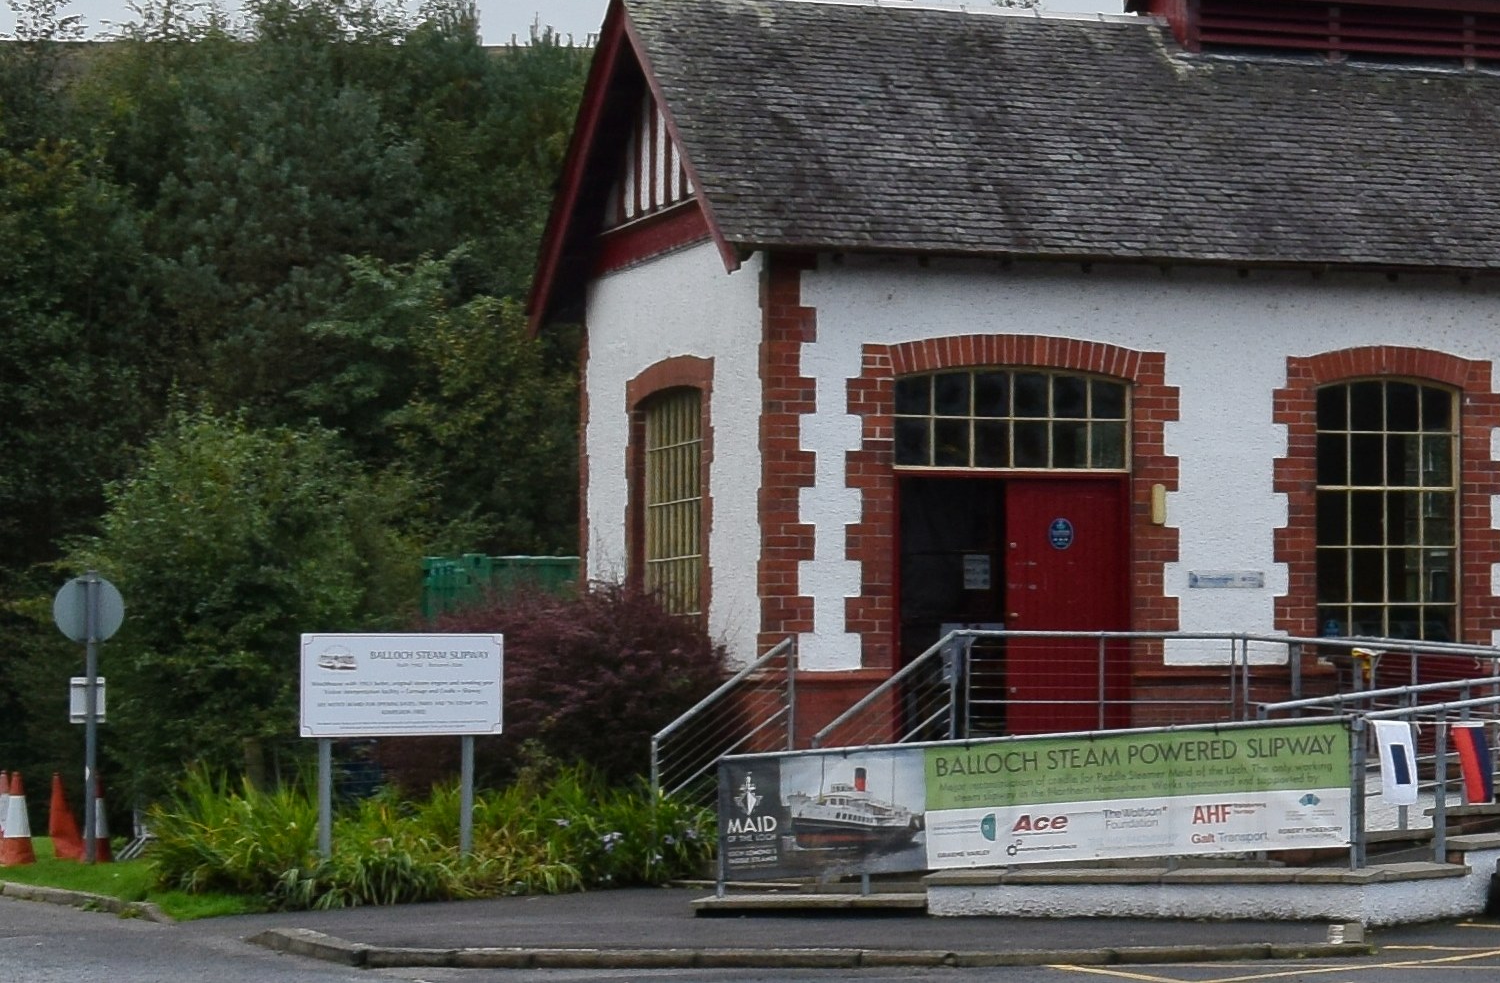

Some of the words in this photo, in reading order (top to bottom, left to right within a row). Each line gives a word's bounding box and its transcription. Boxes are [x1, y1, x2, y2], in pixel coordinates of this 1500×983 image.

[369, 650, 413, 659] BALLOCH
[415, 650, 447, 659] STEAM
[935, 751, 1038, 777] BALLOCH
[1046, 746, 1120, 770] STEAM
[1128, 739, 1238, 767] POWERED
[1246, 734, 1337, 759] SLIPWAY
[1168, 766, 1193, 778] Maid
[1195, 765, 1207, 777] of
[1209, 764, 1223, 776] the
[1271, 762, 1292, 774] only
[1294, 761, 1333, 773] working
[1307, 771, 1320, 784] by
[1102, 809, 1121, 819] The
[1192, 803, 1233, 825] AHF
[727, 815, 777, 834] MAID
[1012, 814, 1068, 832] Ace
[1105, 819, 1159, 829] Foundation
[755, 833, 777, 841] LOCH
[1191, 833, 1216, 844] Galt
[1217, 831, 1268, 844] Transport
